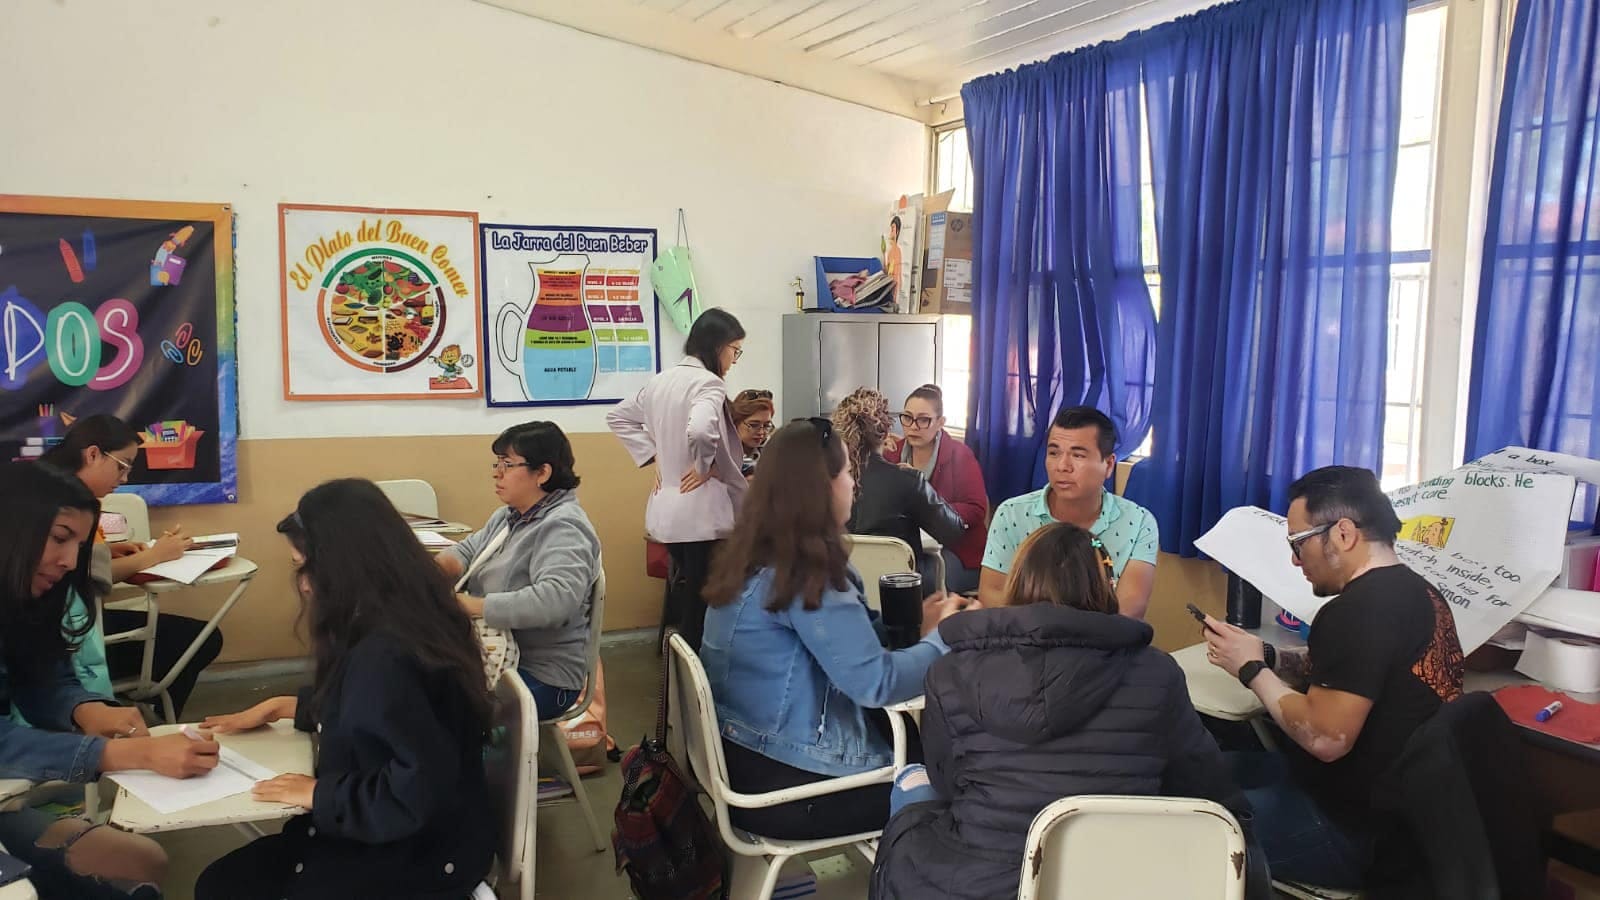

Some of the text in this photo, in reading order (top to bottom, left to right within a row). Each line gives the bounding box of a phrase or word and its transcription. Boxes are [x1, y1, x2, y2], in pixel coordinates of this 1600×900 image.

[492, 231, 648, 253] La Jarra del Buen Beber
[289, 219, 470, 298] El Plato del Buen Comer
[1526, 454, 1555, 466] box
[1514, 473, 1534, 488] He
